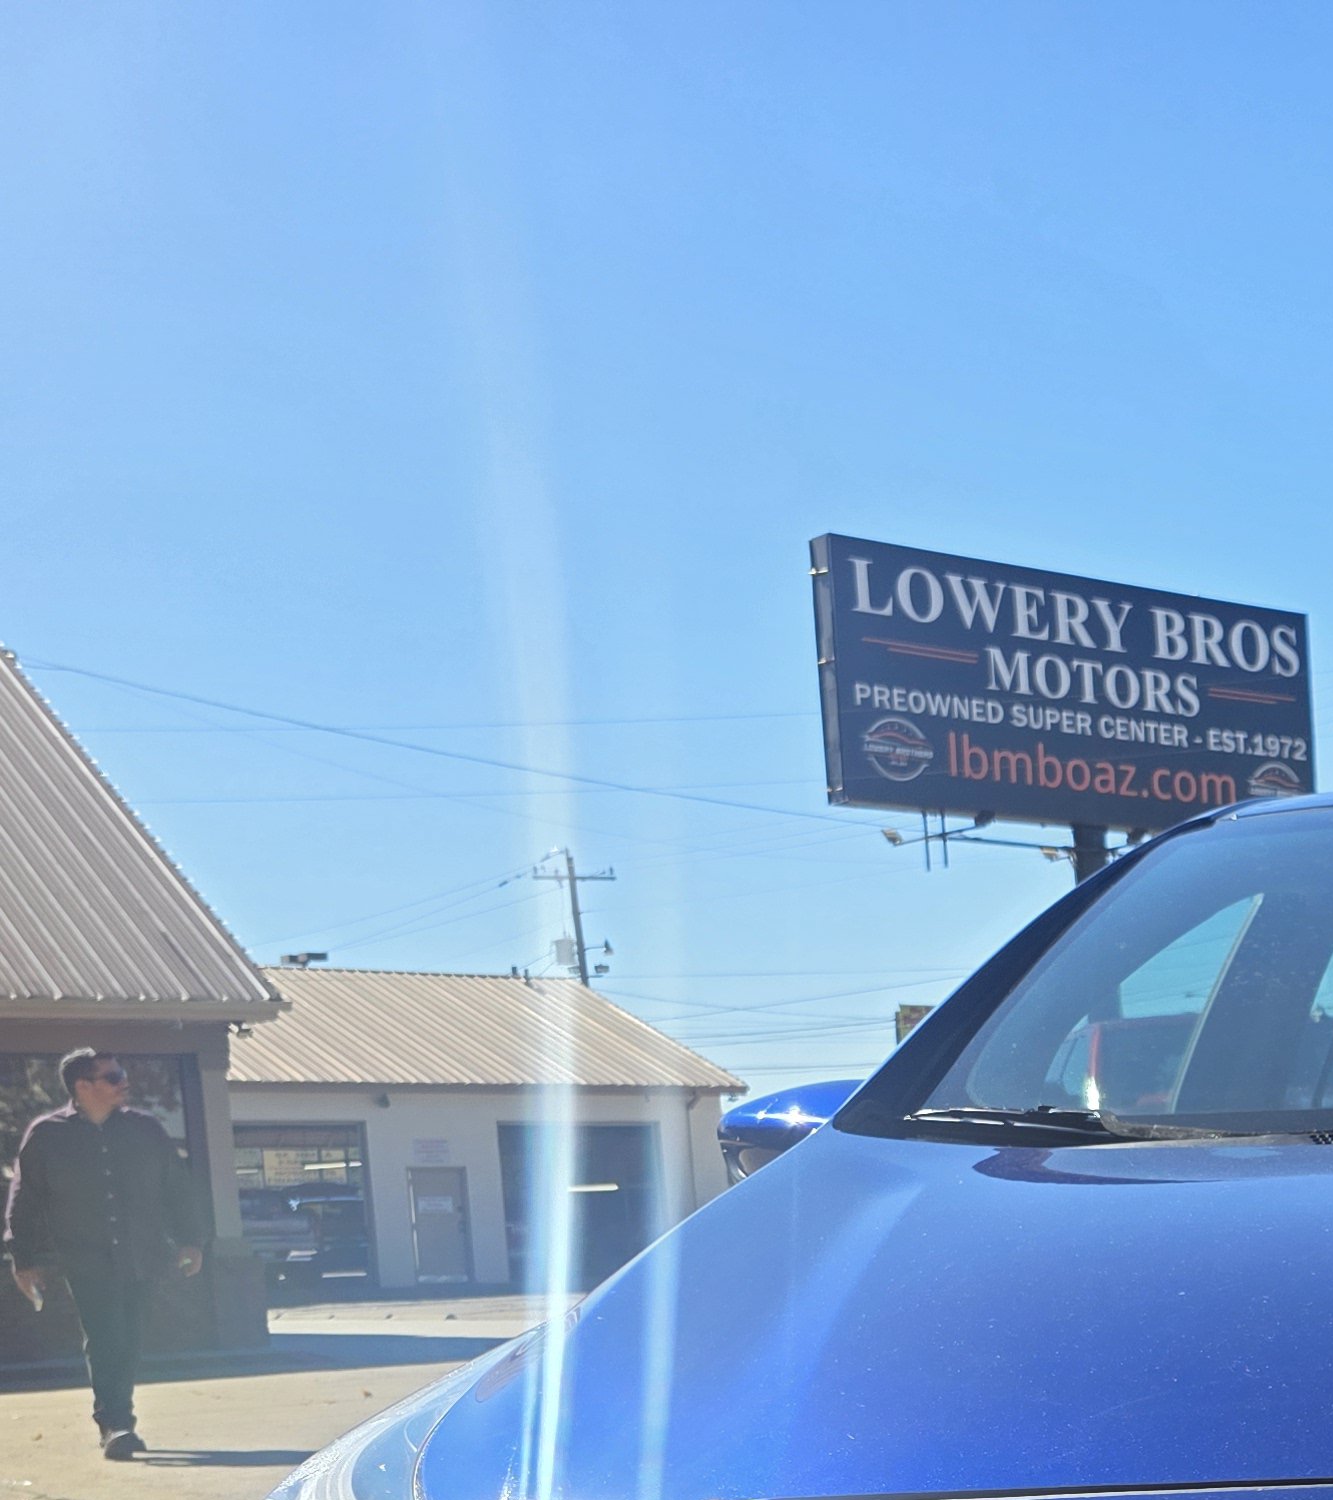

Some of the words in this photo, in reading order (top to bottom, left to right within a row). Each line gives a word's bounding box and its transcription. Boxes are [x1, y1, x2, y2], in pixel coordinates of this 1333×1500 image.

[848, 555, 1133, 653] LOWERY
[1150, 607, 1300, 678] BROS
[855, 682, 1004, 724] PREOWNED
[1010, 704, 1092, 736] SUPER
[1099, 715, 1188, 748] CENTER
[985, 646, 1200, 718] MOTORS
[948, 731, 1237, 804] lbmboaz.com
